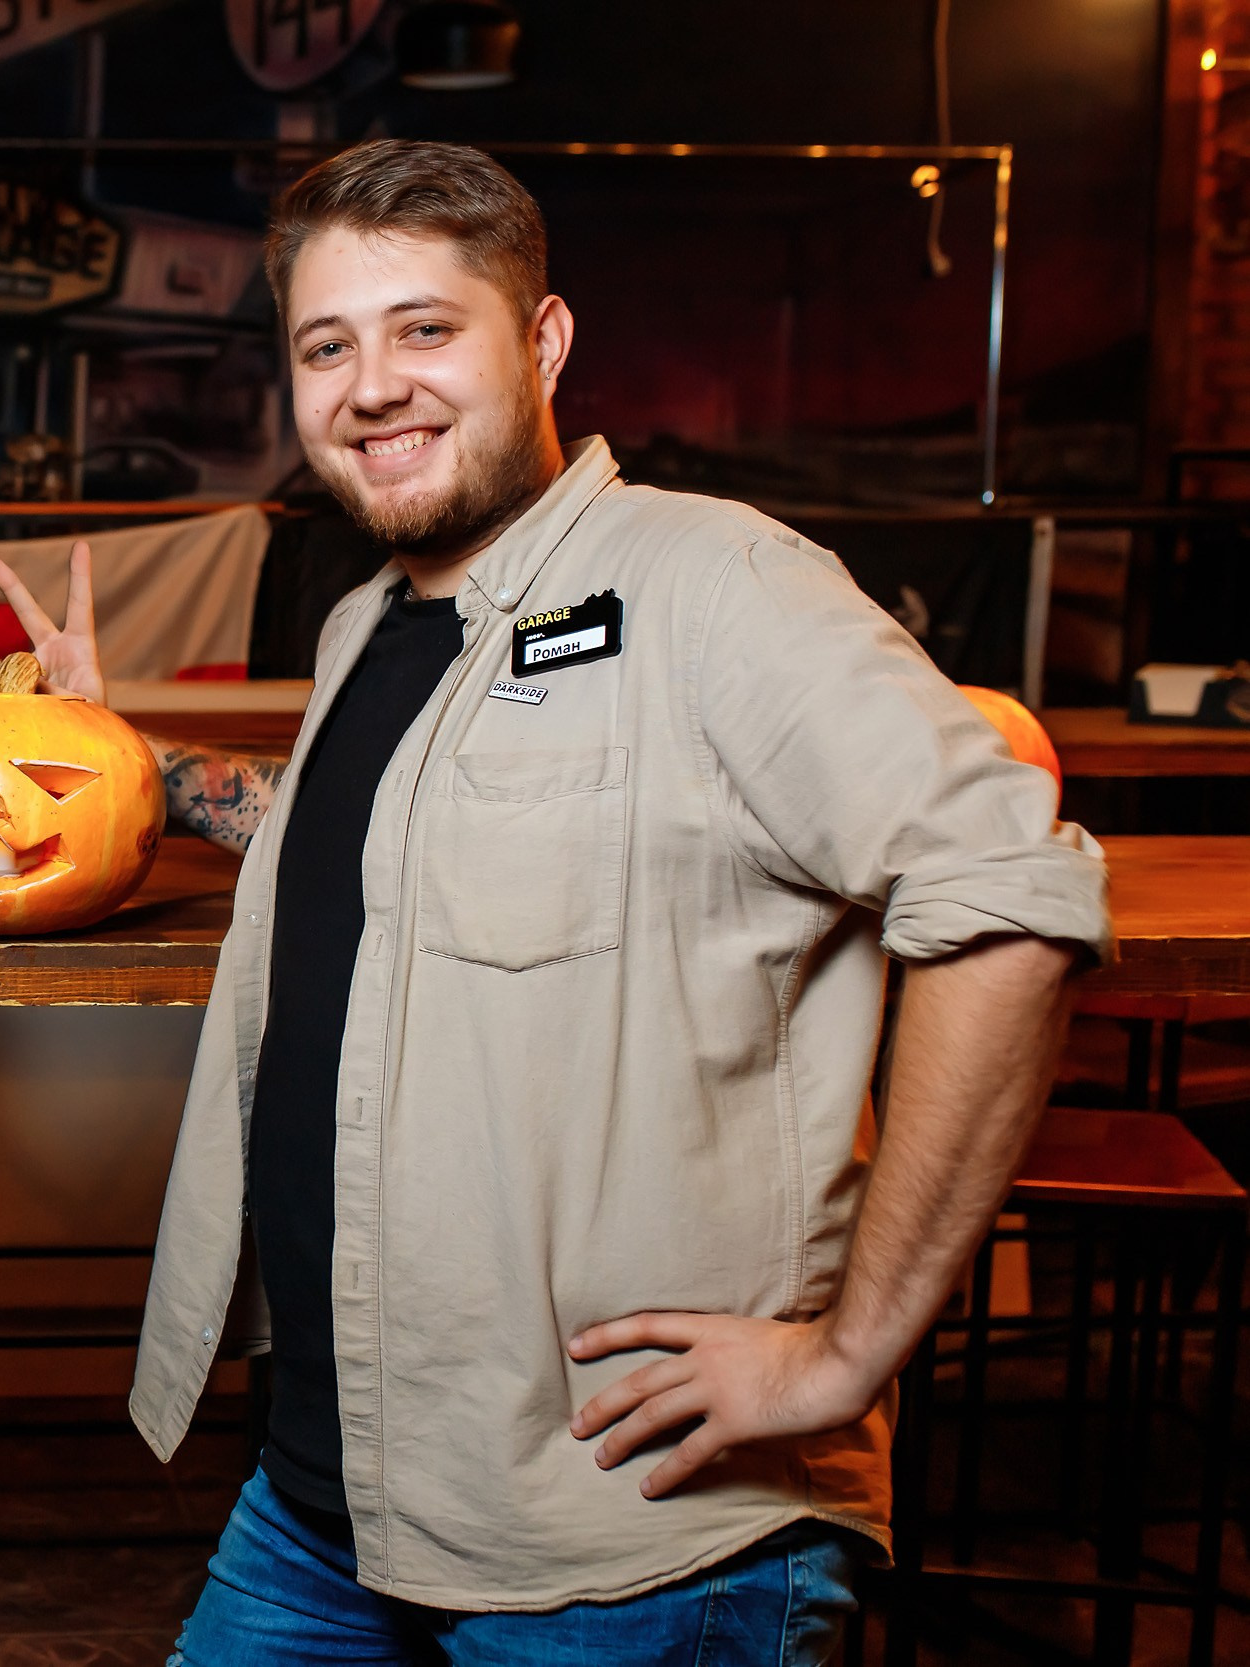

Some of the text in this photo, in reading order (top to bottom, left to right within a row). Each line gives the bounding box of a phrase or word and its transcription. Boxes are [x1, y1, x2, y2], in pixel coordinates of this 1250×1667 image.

[517, 607, 571, 631] GARAGE
[533, 641, 581, 662] Роман
[493, 683, 543, 698] DARKSIDE
